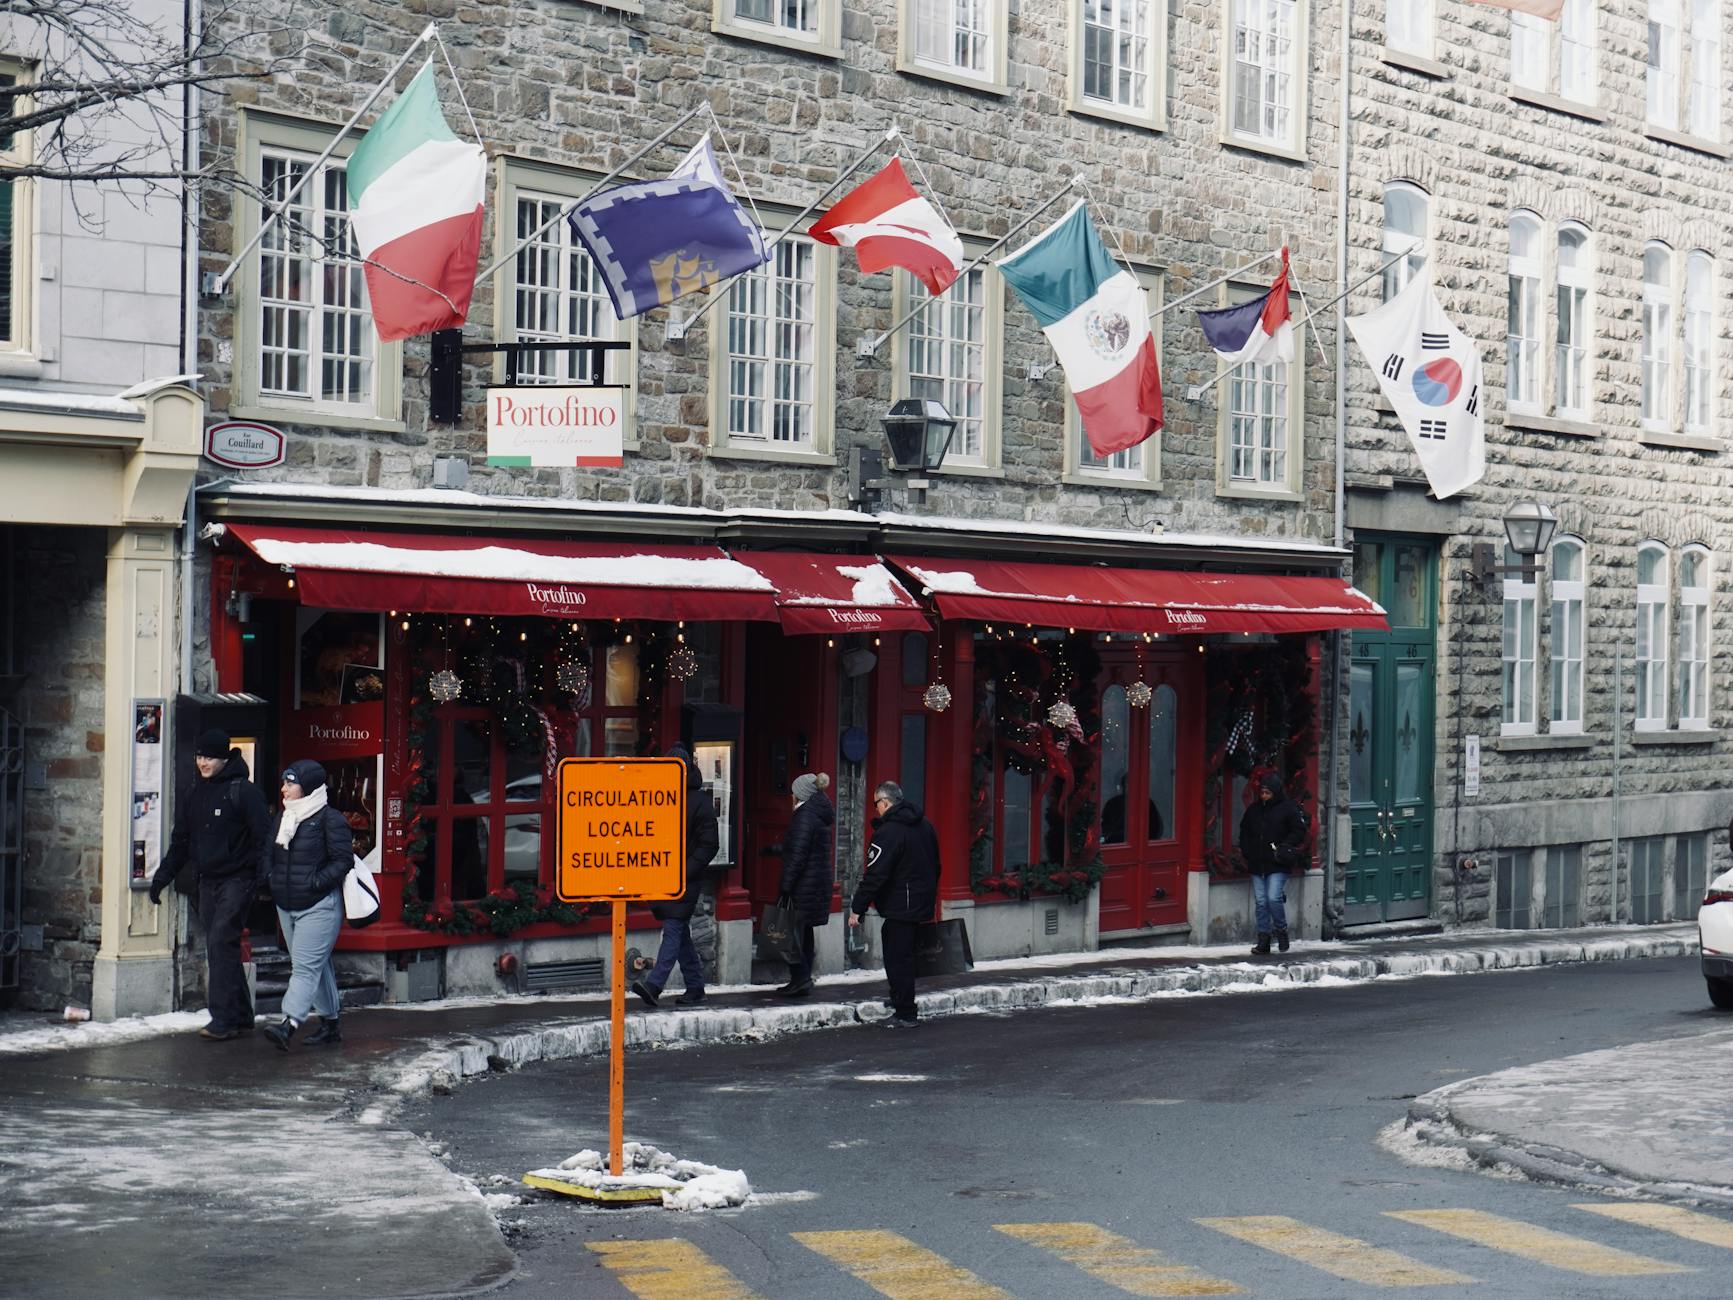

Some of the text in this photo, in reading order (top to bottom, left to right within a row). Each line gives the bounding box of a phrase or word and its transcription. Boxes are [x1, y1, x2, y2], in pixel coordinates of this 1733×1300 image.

[495, 395, 616, 427] Portofino
[228, 437, 264, 450] Couillard
[526, 583, 587, 605] Portofino
[827, 608, 882, 623] Portofino
[1165, 608, 1207, 623] Portofino
[1359, 643, 1369, 657] 48
[309, 724, 370, 740] Portofino
[567, 790, 677, 807] CIRCULATION
[588, 821, 655, 837] LOCALE
[571, 851, 671, 868] SEULEMENT
